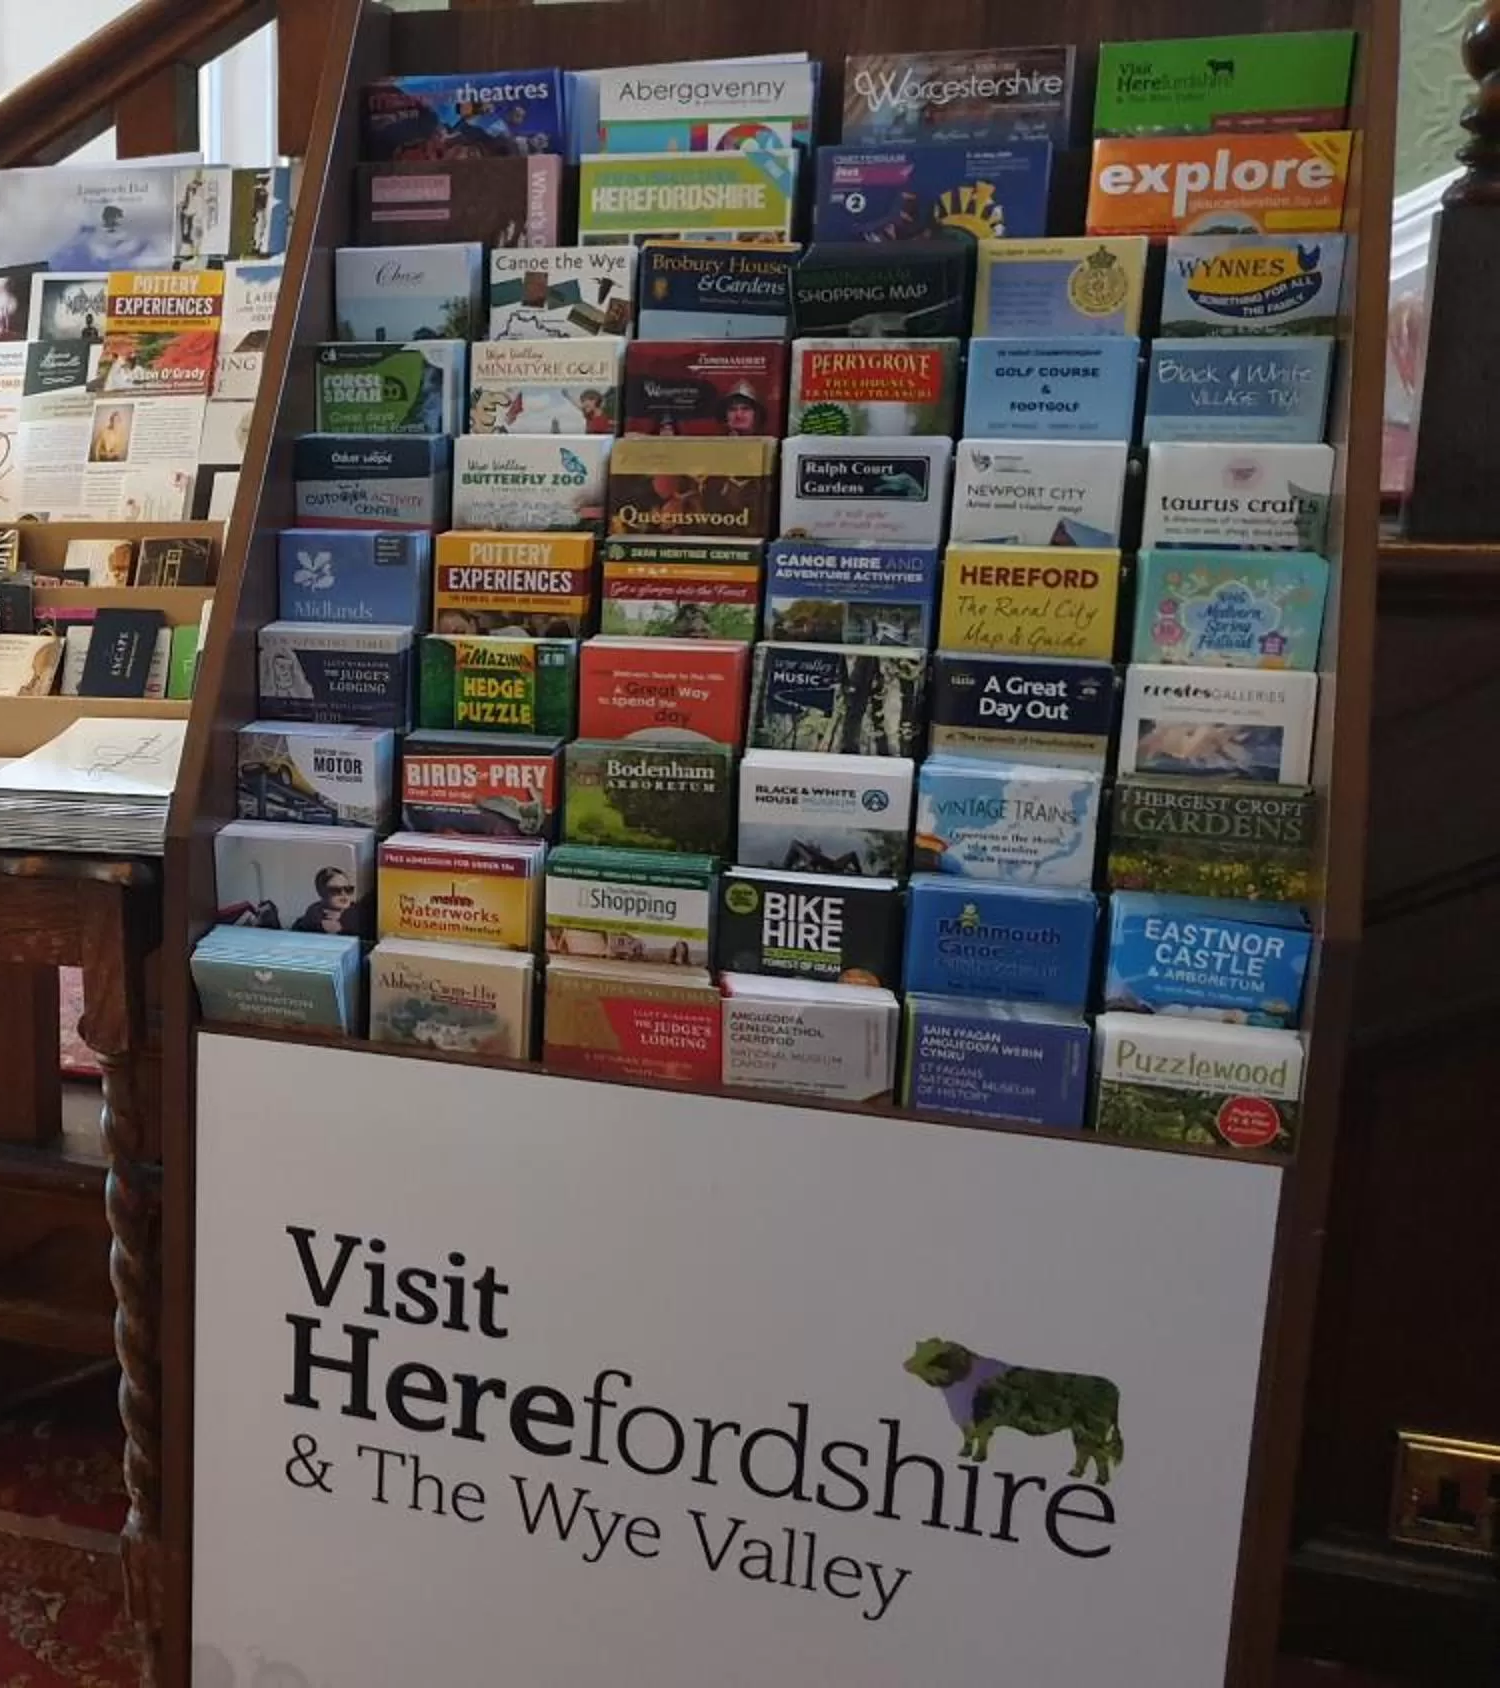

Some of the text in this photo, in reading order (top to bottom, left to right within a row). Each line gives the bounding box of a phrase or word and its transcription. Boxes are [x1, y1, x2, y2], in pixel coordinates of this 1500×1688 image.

[455, 82, 549, 104] theatres
[619, 79, 786, 105] Abergavenny
[854, 67, 1064, 112] Worcestershire
[1099, 147, 1336, 218] explore
[591, 183, 767, 213] HEREFORDSHIRE
[495, 251, 626, 272] Canoe the Wye
[651, 253, 788, 275] Brobury House
[1177, 256, 1286, 279] WYNNES
[132, 275, 200, 294] POTTERY
[797, 282, 929, 304] SHOPPING MAP
[1263, 283, 1289, 299] FOR
[1291, 276, 1316, 292] ALL
[114, 297, 214, 316] EXPERIENCES
[811, 351, 932, 380] PERRYGROVE
[995, 367, 1101, 378] GOLF COURSE
[1040, 384, 1052, 395] &
[1009, 401, 1081, 413] FOOTGOLF
[461, 472, 586, 486] BUTTERFLY ZOO
[805, 461, 894, 478] Ralph Court
[804, 480, 865, 494] Gardens
[966, 484, 1087, 501] NEWPORT CITY
[1160, 495, 1318, 514] taurus crafts
[618, 505, 749, 527] Queenswood
[469, 542, 553, 567] POTTERY
[709, 551, 750, 561] CENTRE
[775, 553, 925, 571] CANOE HIRE AND
[448, 567, 573, 593] EXPERIENCES
[775, 568, 925, 584] ADVENTURE ACTIVITIES
[959, 563, 1100, 590] HEREFORD
[293, 599, 374, 620] Midlands
[957, 594, 1102, 630] The Rural City
[963, 619, 1001, 650] Map
[1027, 626, 1090, 651] Guide
[329, 682, 387, 696] LODGING
[463, 676, 526, 699] HEDGE
[772, 670, 822, 686] MUSIC
[983, 675, 1069, 698] A Great
[611, 695, 657, 708] spend
[624, 681, 676, 697] Great
[678, 687, 709, 701] Way
[457, 701, 534, 726] PUZZLE
[653, 709, 691, 728] day
[978, 697, 1070, 723] Day Out
[313, 756, 363, 775] MOTOR
[405, 763, 549, 790] BIRDS PREY
[605, 759, 716, 780] Bodenham
[605, 779, 716, 794] ARBORETUM
[754, 784, 857, 799] BLACK & WHITE
[754, 795, 799, 806] HOUSE
[936, 798, 1079, 825] VINTAGE TRAINS
[1135, 789, 1309, 818] HERGEST CROFT
[1133, 806, 1304, 842] GARDENS
[399, 903, 500, 924] Waterworks
[590, 887, 678, 921] Shopping
[763, 891, 845, 926] BIKE
[399, 914, 461, 933] Museum
[937, 916, 1062, 945] Monmouth
[762, 919, 844, 953] HIRE
[1144, 917, 1286, 960] EASTNOR
[1155, 942, 1267, 978] CASTLE
[1163, 967, 1266, 993] ARBORETUM
[652, 1019, 713, 1038] JUDGE'S
[639, 1033, 708, 1050] LODGING
[1116, 1038, 1288, 1089] Puzzlewood
[285, 1225, 510, 1339] Visit
[282, 1311, 1117, 1560] Herefordshire
[283, 1432, 913, 1621] & The Wye Valley
